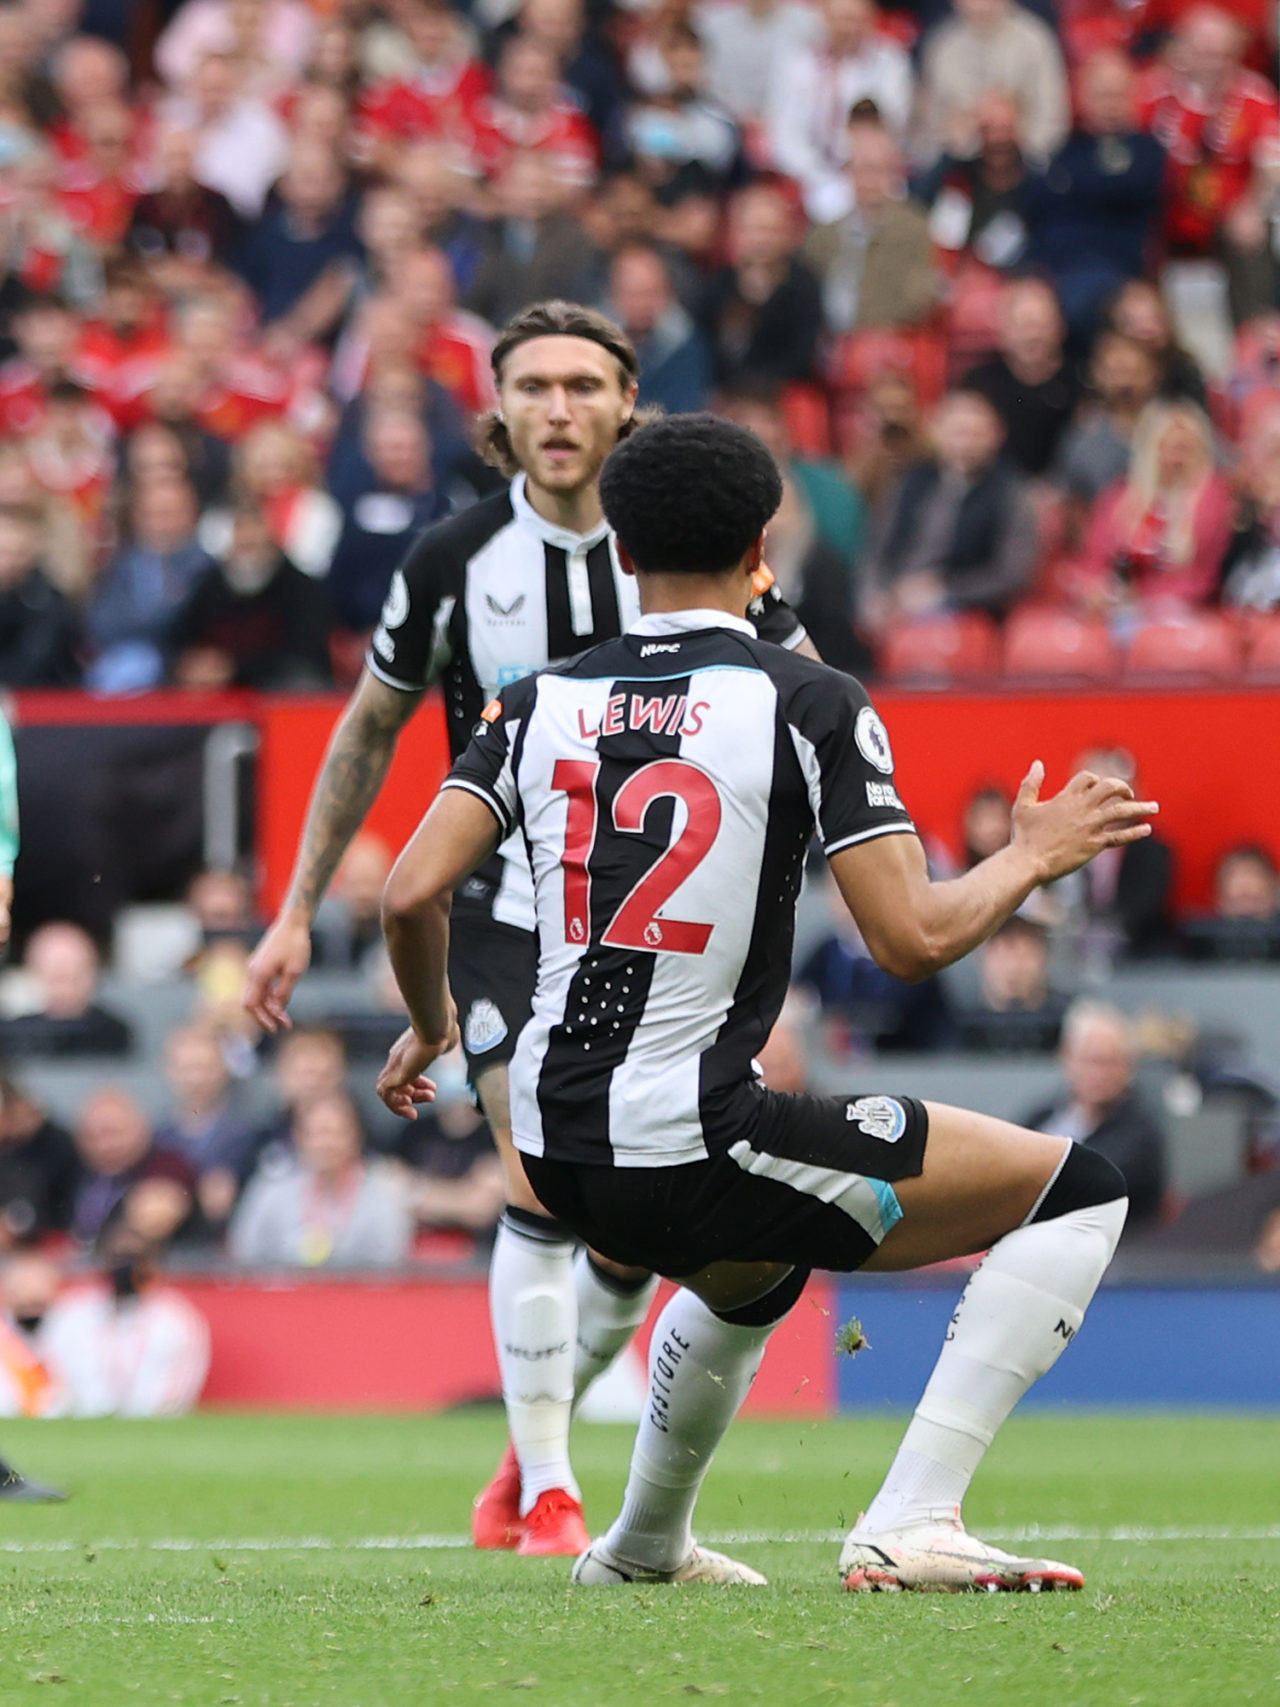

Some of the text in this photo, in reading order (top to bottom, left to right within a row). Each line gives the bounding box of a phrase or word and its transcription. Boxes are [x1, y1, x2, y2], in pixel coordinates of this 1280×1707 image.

[640, 643, 681, 658] NUFC
[578, 693, 711, 739] LEWIS
[551, 757, 722, 955] 12
[650, 1328, 690, 1433] CASTORE
